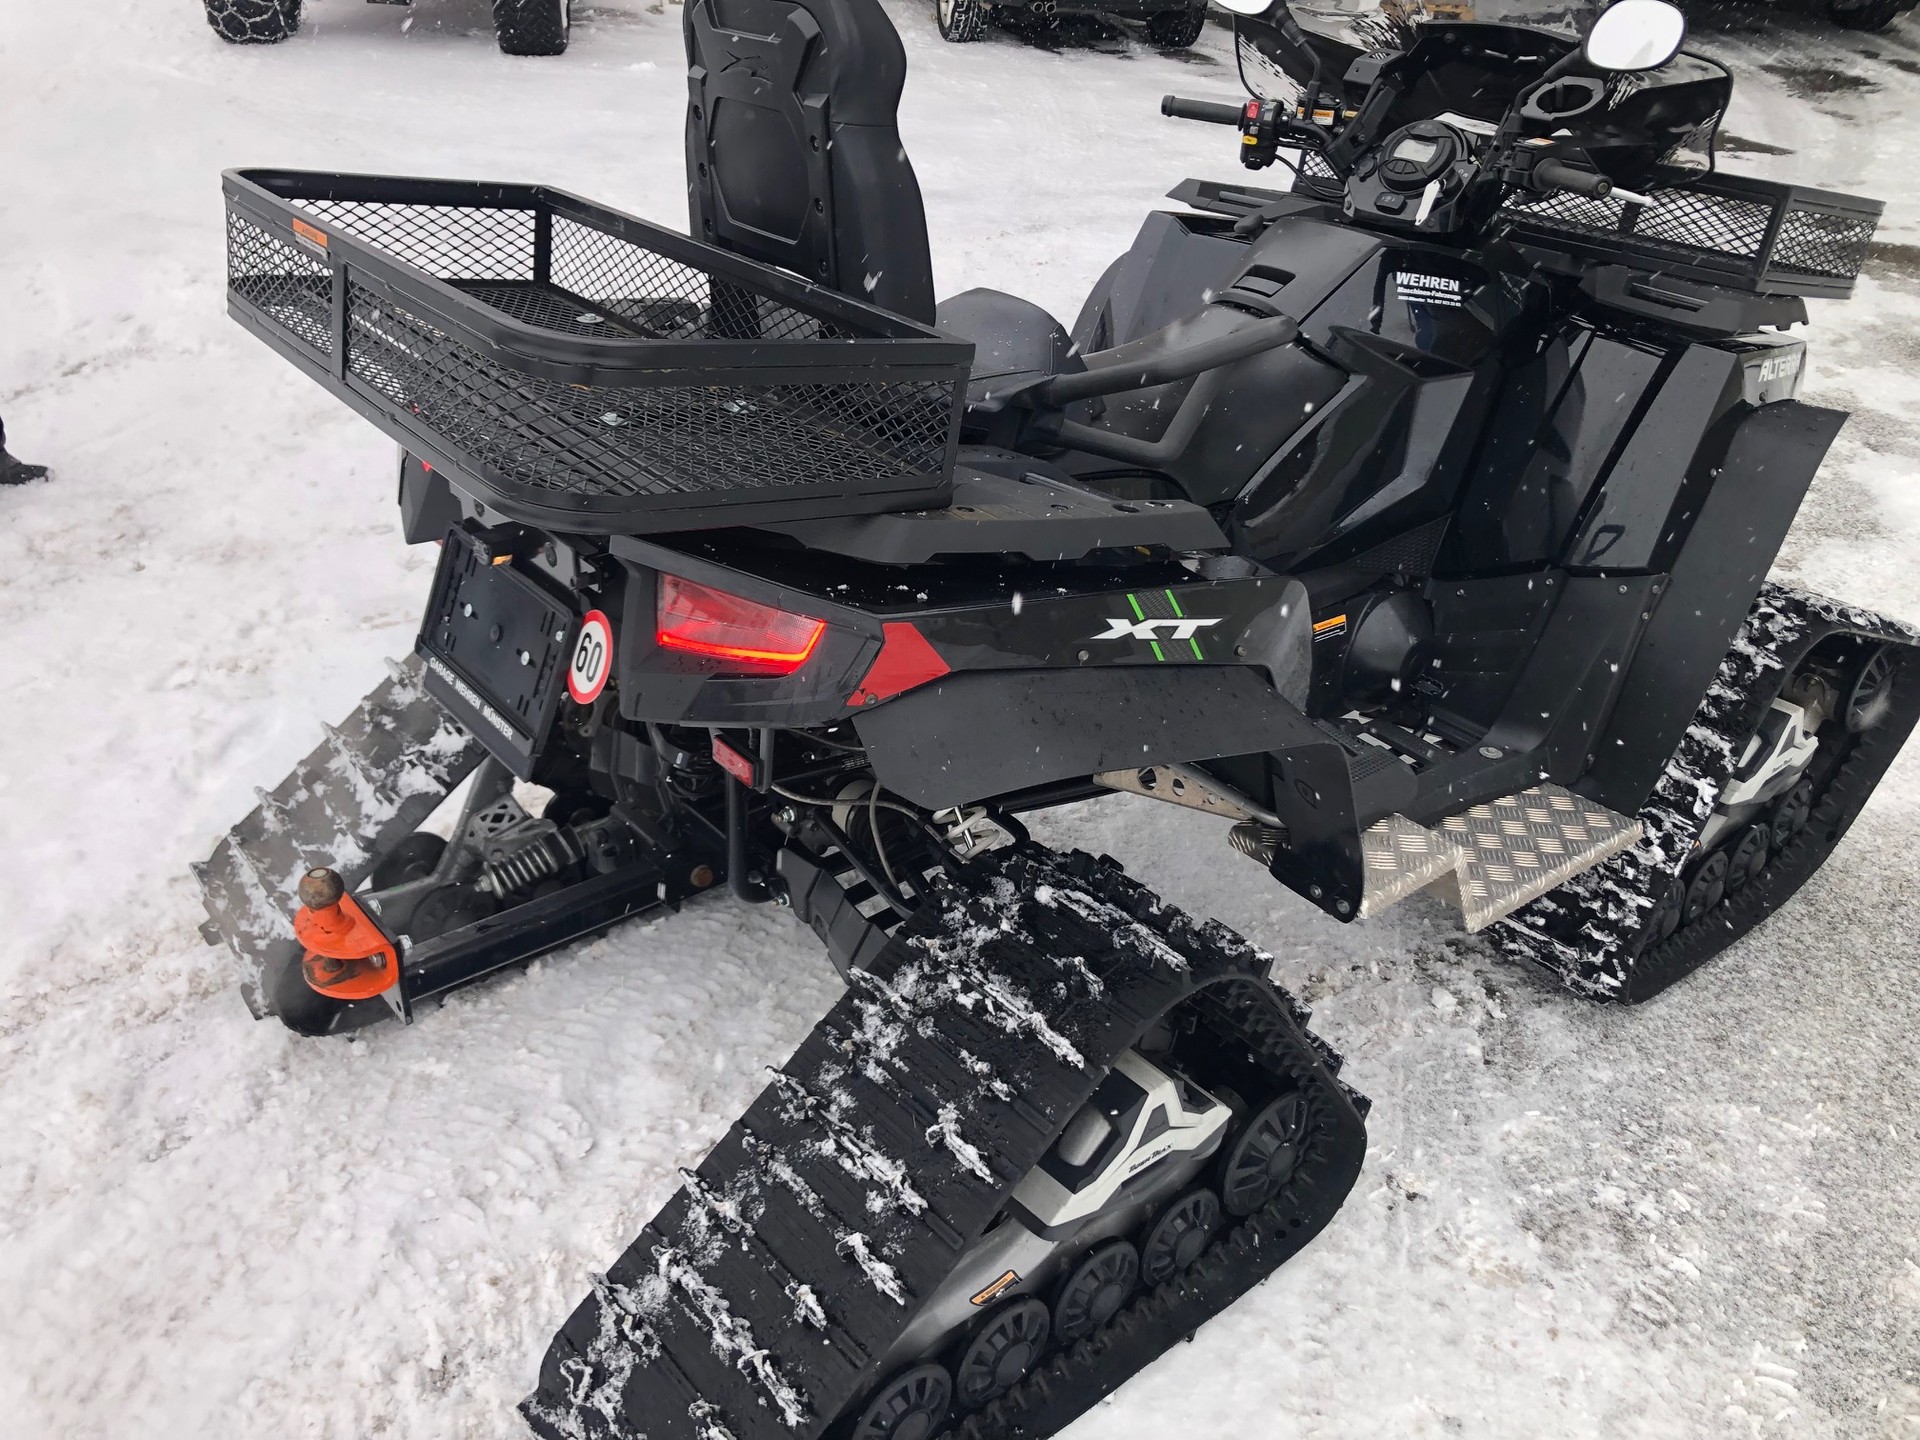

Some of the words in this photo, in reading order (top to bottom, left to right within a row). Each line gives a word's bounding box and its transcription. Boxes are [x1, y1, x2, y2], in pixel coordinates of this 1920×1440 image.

[1396, 271, 1459, 292] WEHREN
[1089, 618, 1223, 640] XT
[576, 632, 602, 683] 60
[429, 657, 455, 686] GARAGE
[455, 678, 481, 710] WEHREN
[482, 704, 514, 741] MÜNSTER
